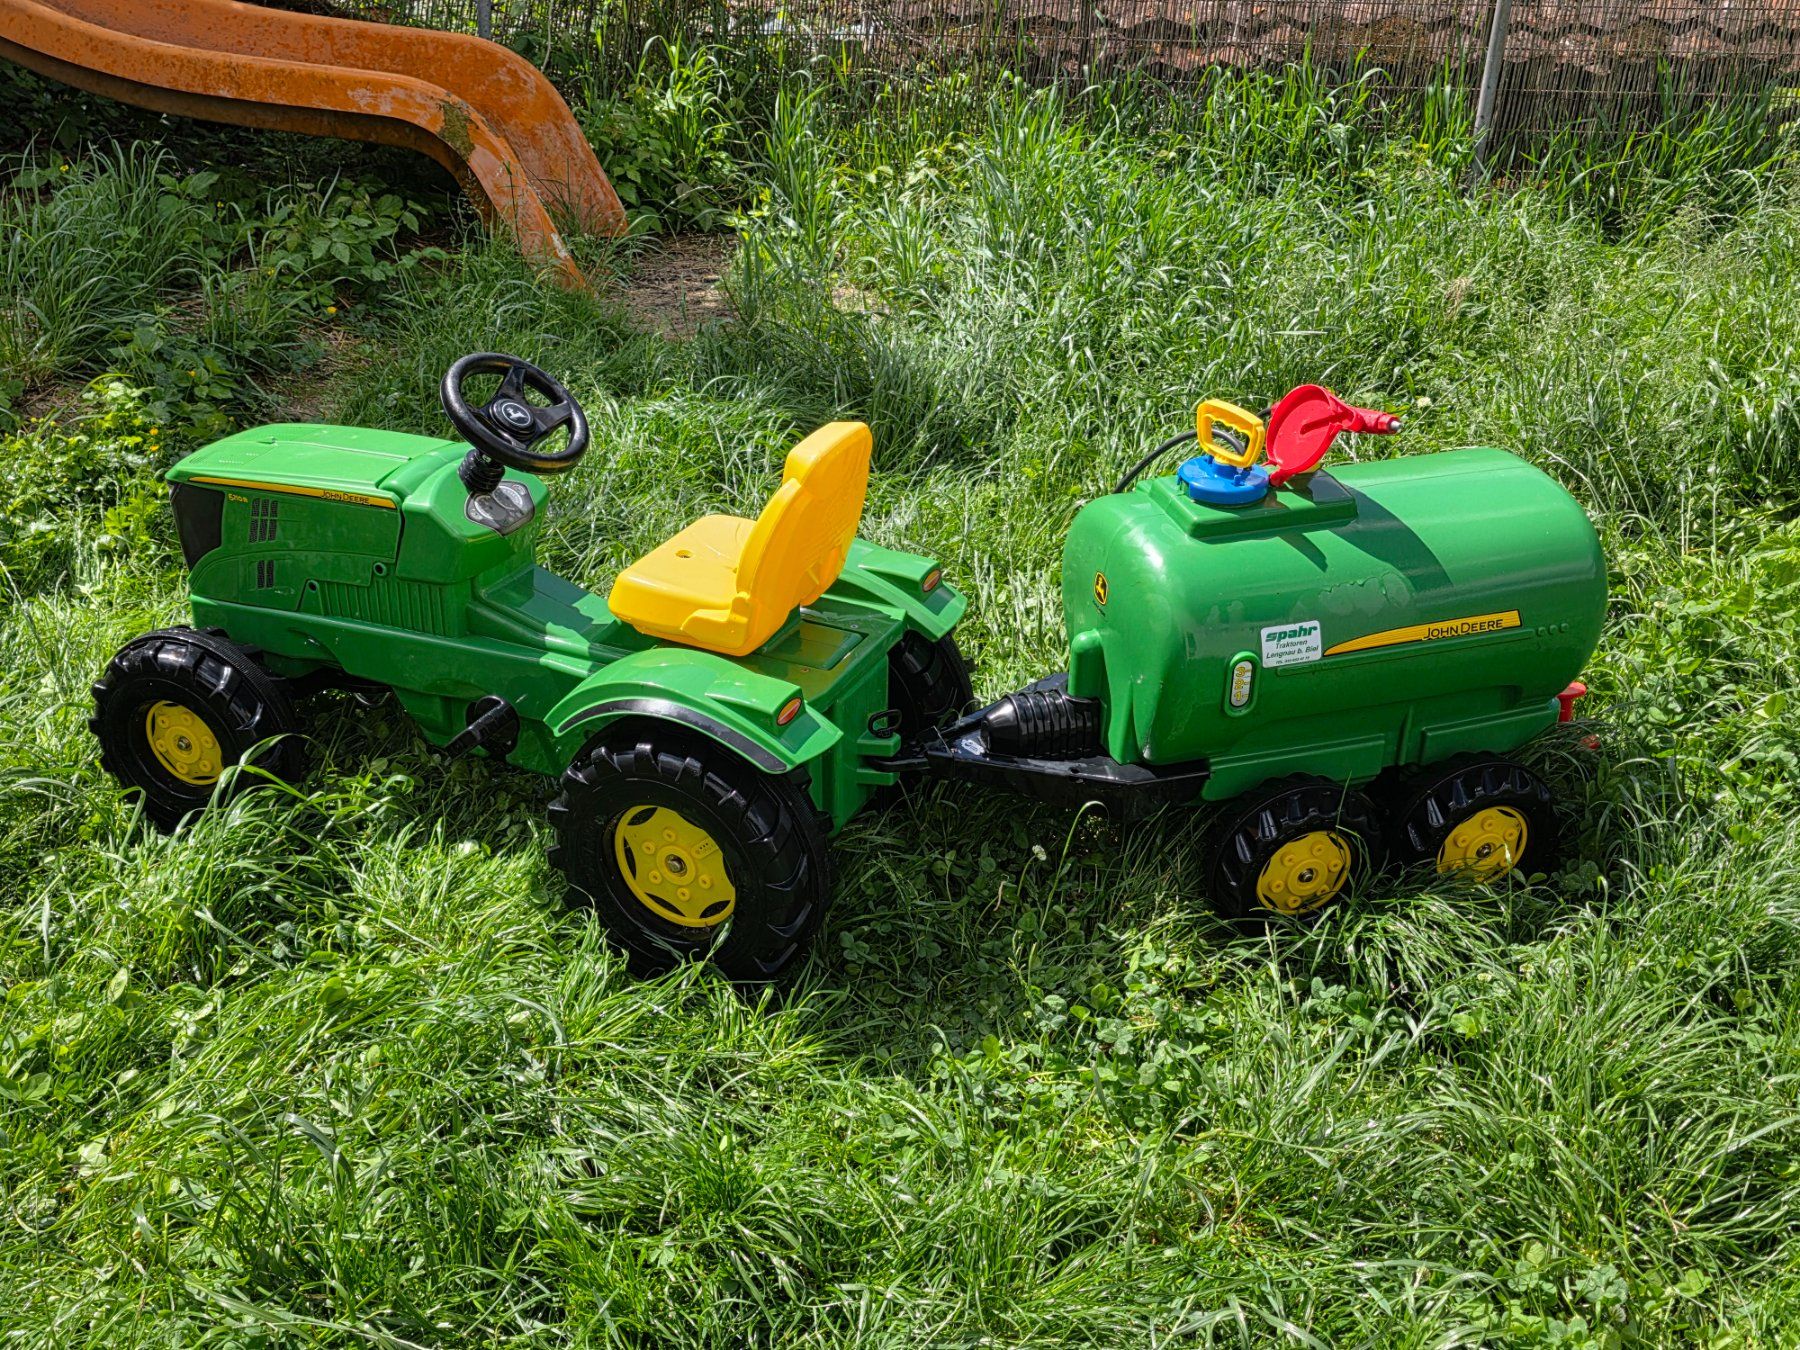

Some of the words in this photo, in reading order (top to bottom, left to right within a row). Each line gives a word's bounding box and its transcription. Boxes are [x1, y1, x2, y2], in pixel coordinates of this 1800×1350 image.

[322, 490, 342, 501] JOHN
[343, 492, 370, 504] DEERE
[1265, 626, 1317, 642] spahr
[1424, 626, 1459, 638] JOHN
[1460, 619, 1503, 633] DEERE
[1276, 640, 1308, 649] Traktoren
[1266, 650, 1296, 659] Lengnau
[1235, 666, 1245, 677] 3
[1234, 679, 1244, 690] 2
[1233, 691, 1242, 702] 1
